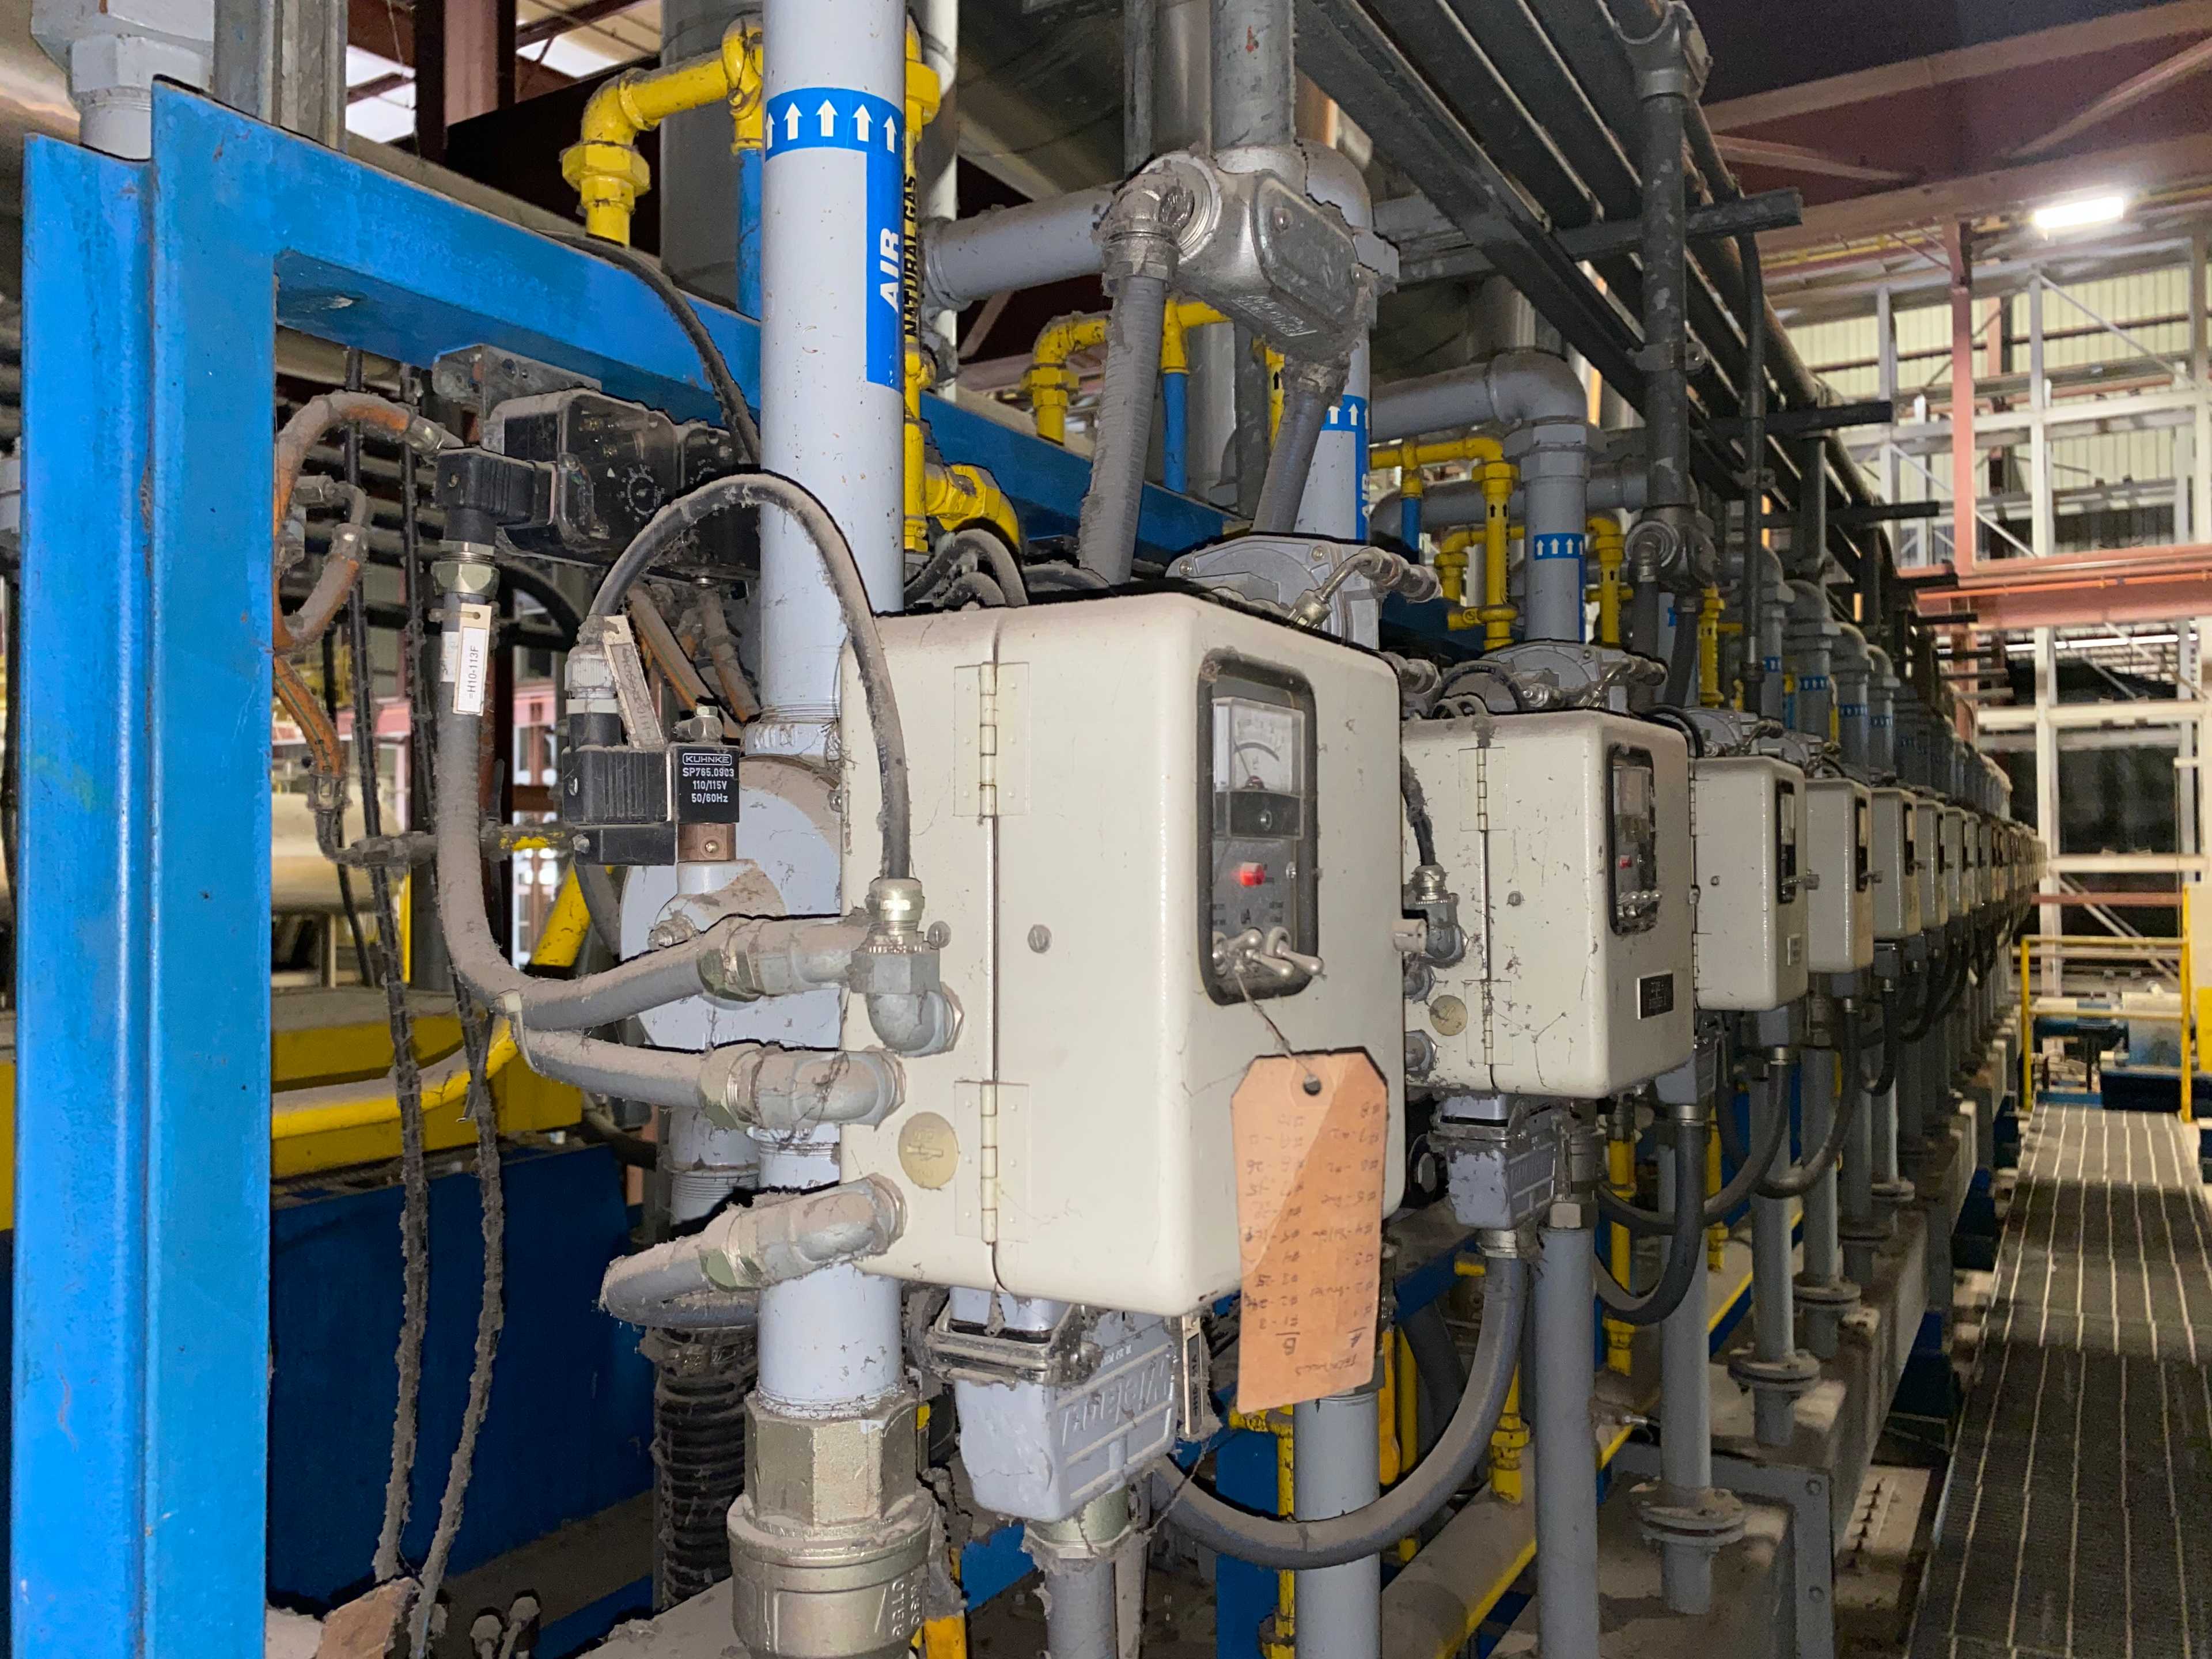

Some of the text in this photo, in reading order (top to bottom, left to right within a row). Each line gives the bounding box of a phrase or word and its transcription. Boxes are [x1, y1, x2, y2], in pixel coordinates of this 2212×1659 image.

[903, 174, 918, 336] NATURAL GAS
[880, 228, 899, 313] AIR
[685, 755, 730, 764] KUHNKE
[682, 767, 735, 778] SP765.0903
[692, 780, 727, 791] 110/115V
[691, 793, 729, 804] 50/60Hz
